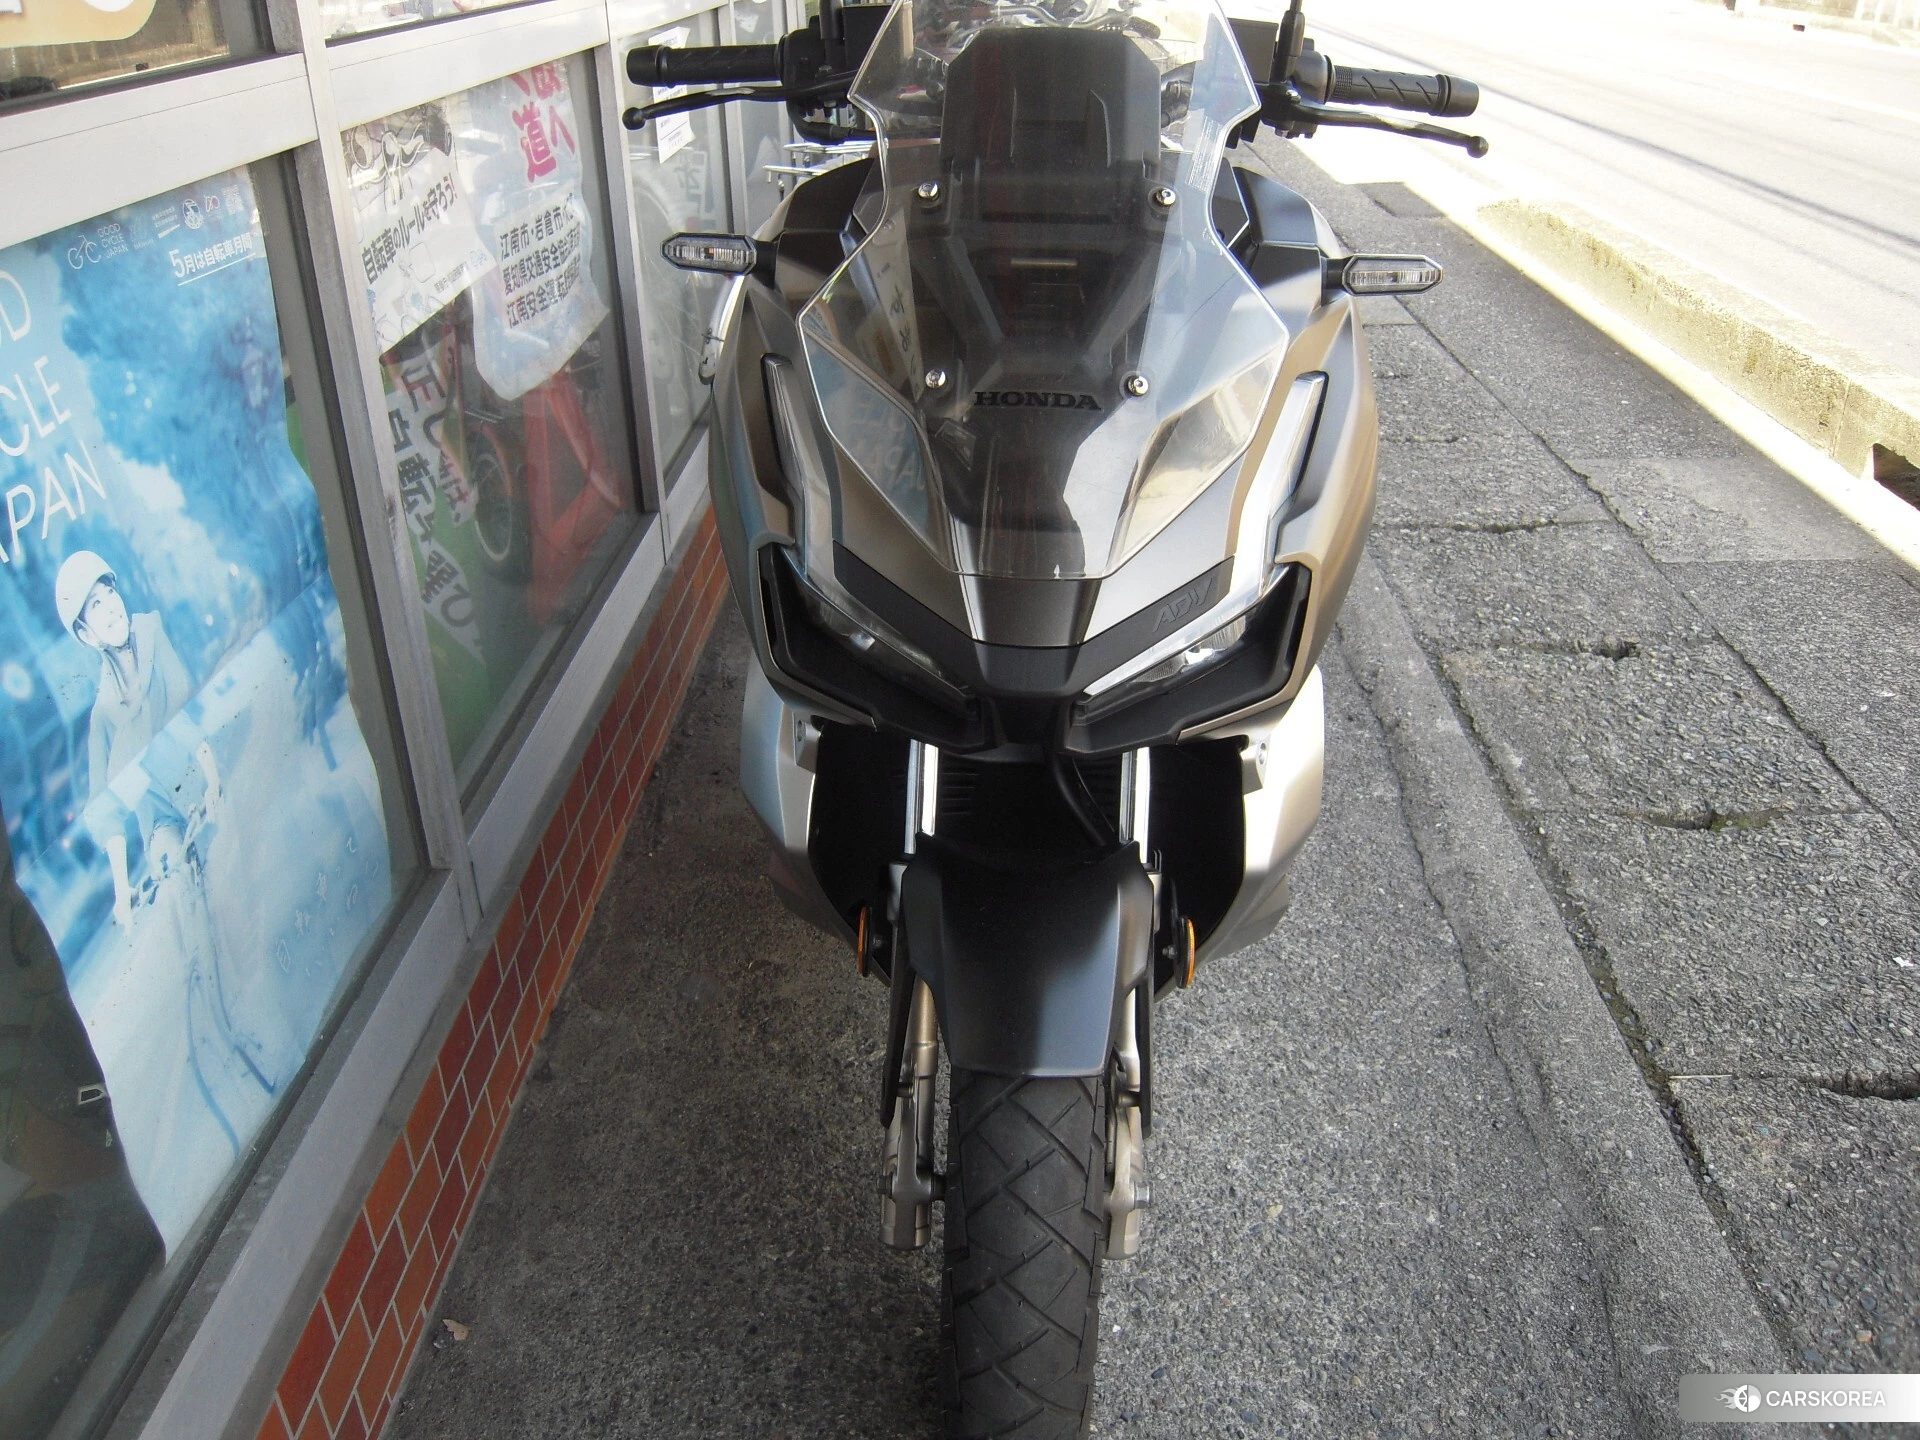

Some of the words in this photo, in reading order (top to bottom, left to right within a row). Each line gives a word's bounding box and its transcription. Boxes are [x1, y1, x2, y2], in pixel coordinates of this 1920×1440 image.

[97, 223, 121, 238] GOOD
[101, 233, 125, 250] CYCLE
[105, 244, 129, 259] JAPAN
[168, 232, 254, 278] 5月は自転車月間
[974, 391, 1102, 411] HONDA
[0, 440, 107, 564] PAN
[1152, 574, 1215, 634] ADV
